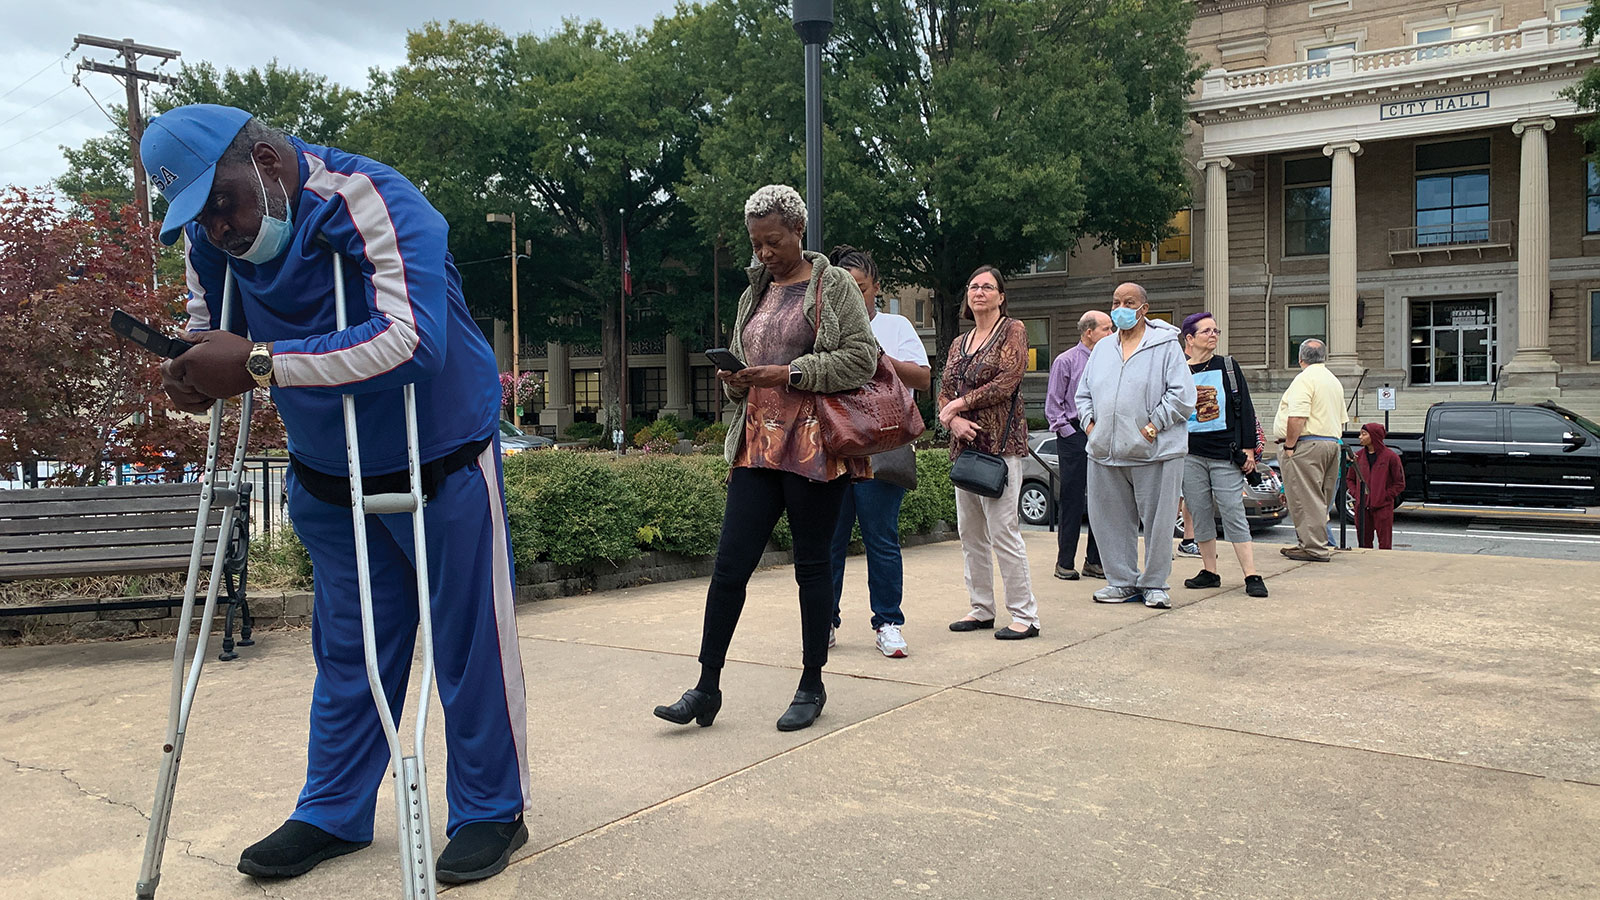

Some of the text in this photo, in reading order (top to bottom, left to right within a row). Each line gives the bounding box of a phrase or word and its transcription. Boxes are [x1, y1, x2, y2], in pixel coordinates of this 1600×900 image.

[1389, 96, 1480, 116] CITY HALL
[151, 165, 179, 192] SA
